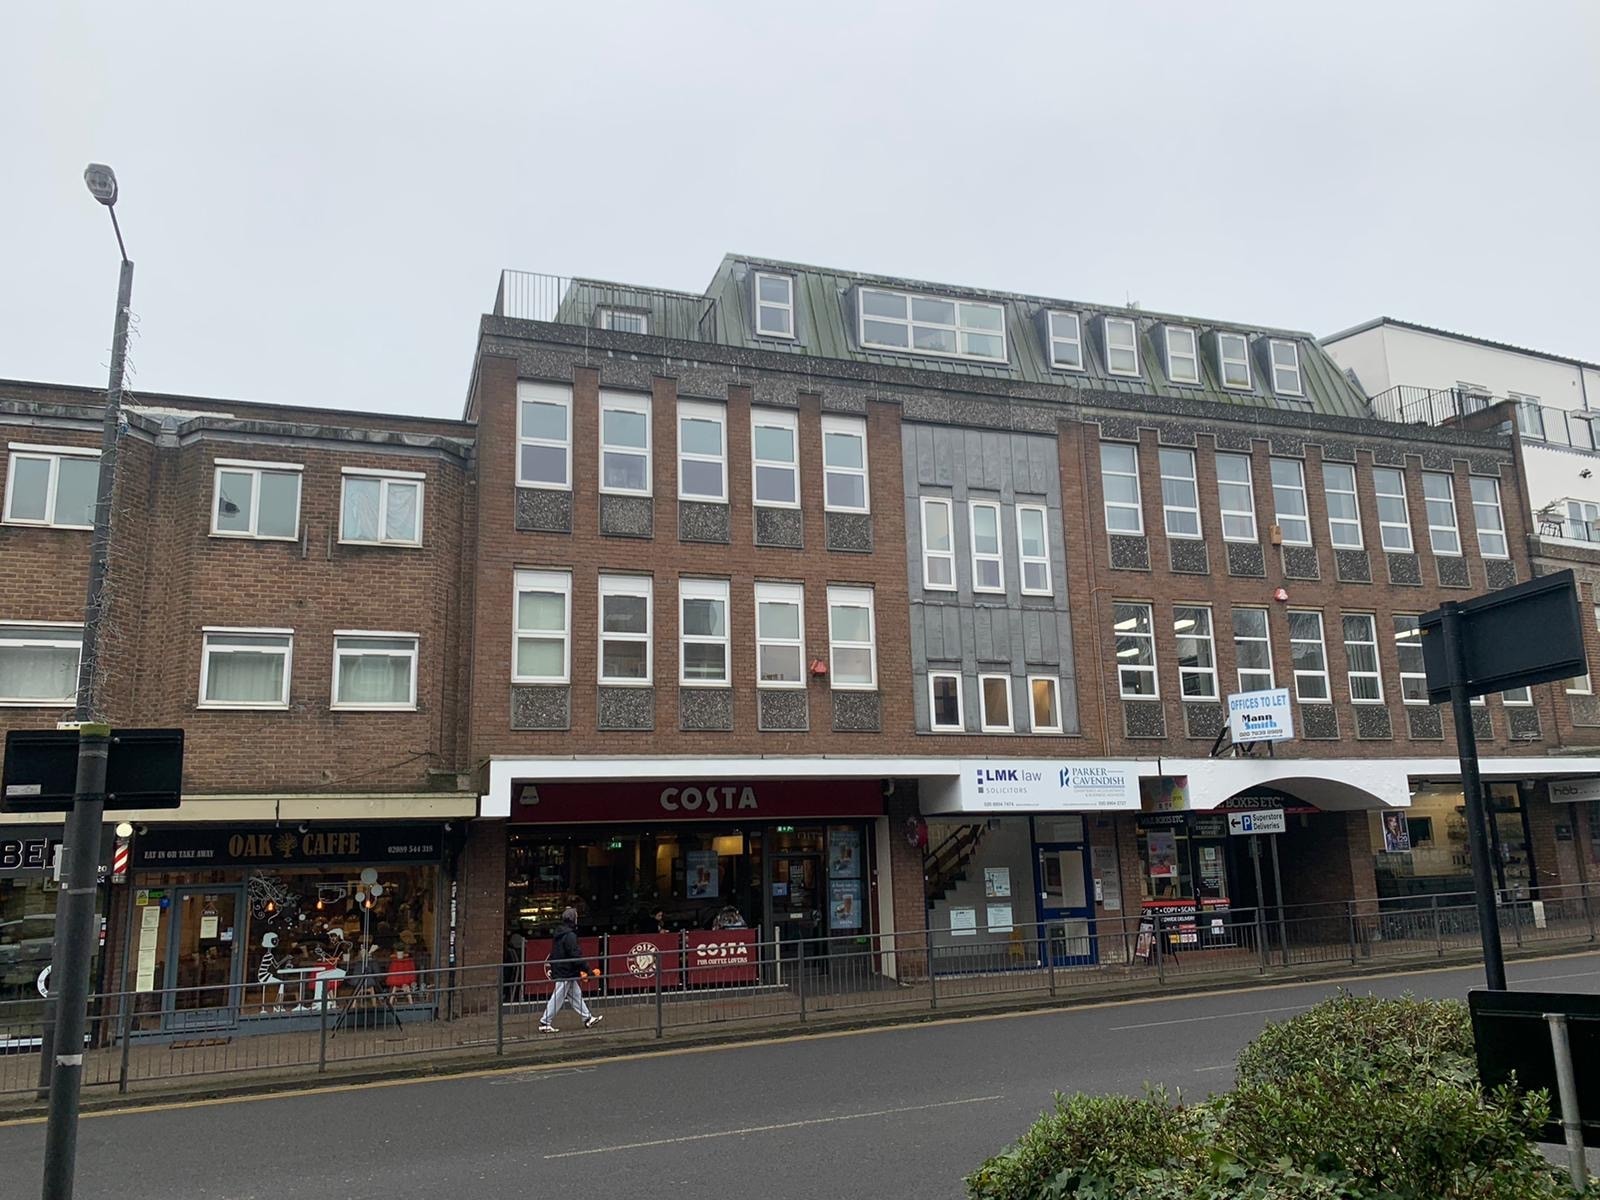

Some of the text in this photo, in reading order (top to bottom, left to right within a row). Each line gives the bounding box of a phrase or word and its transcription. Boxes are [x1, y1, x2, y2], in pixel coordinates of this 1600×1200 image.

[1231, 694, 1287, 711] OFFICES TO LET
[1242, 714, 1273, 722] Mann
[1244, 720, 1278, 730] Smith
[985, 769, 1042, 781] LMK law
[1072, 767, 1108, 776] PARKER
[1072, 776, 1125, 785] CAVENDISH
[660, 786, 758, 814] COSTA
[1226, 796, 1259, 808] BOXES
[1253, 812, 1282, 822] Superstore
[1253, 821, 1280, 831] Deliveries
[228, 832, 360, 857] OAK CAFFE
[144, 851, 156, 859] EAT
[166, 850, 177, 858] OR
[178, 850, 195, 858] TAKE
[196, 850, 215, 858] AWAY
[1163, 905, 1196, 914] COPY SCAN
[696, 942, 748, 957] COSTA
[697, 956, 748, 966] FOR COFFEE LOVERS
